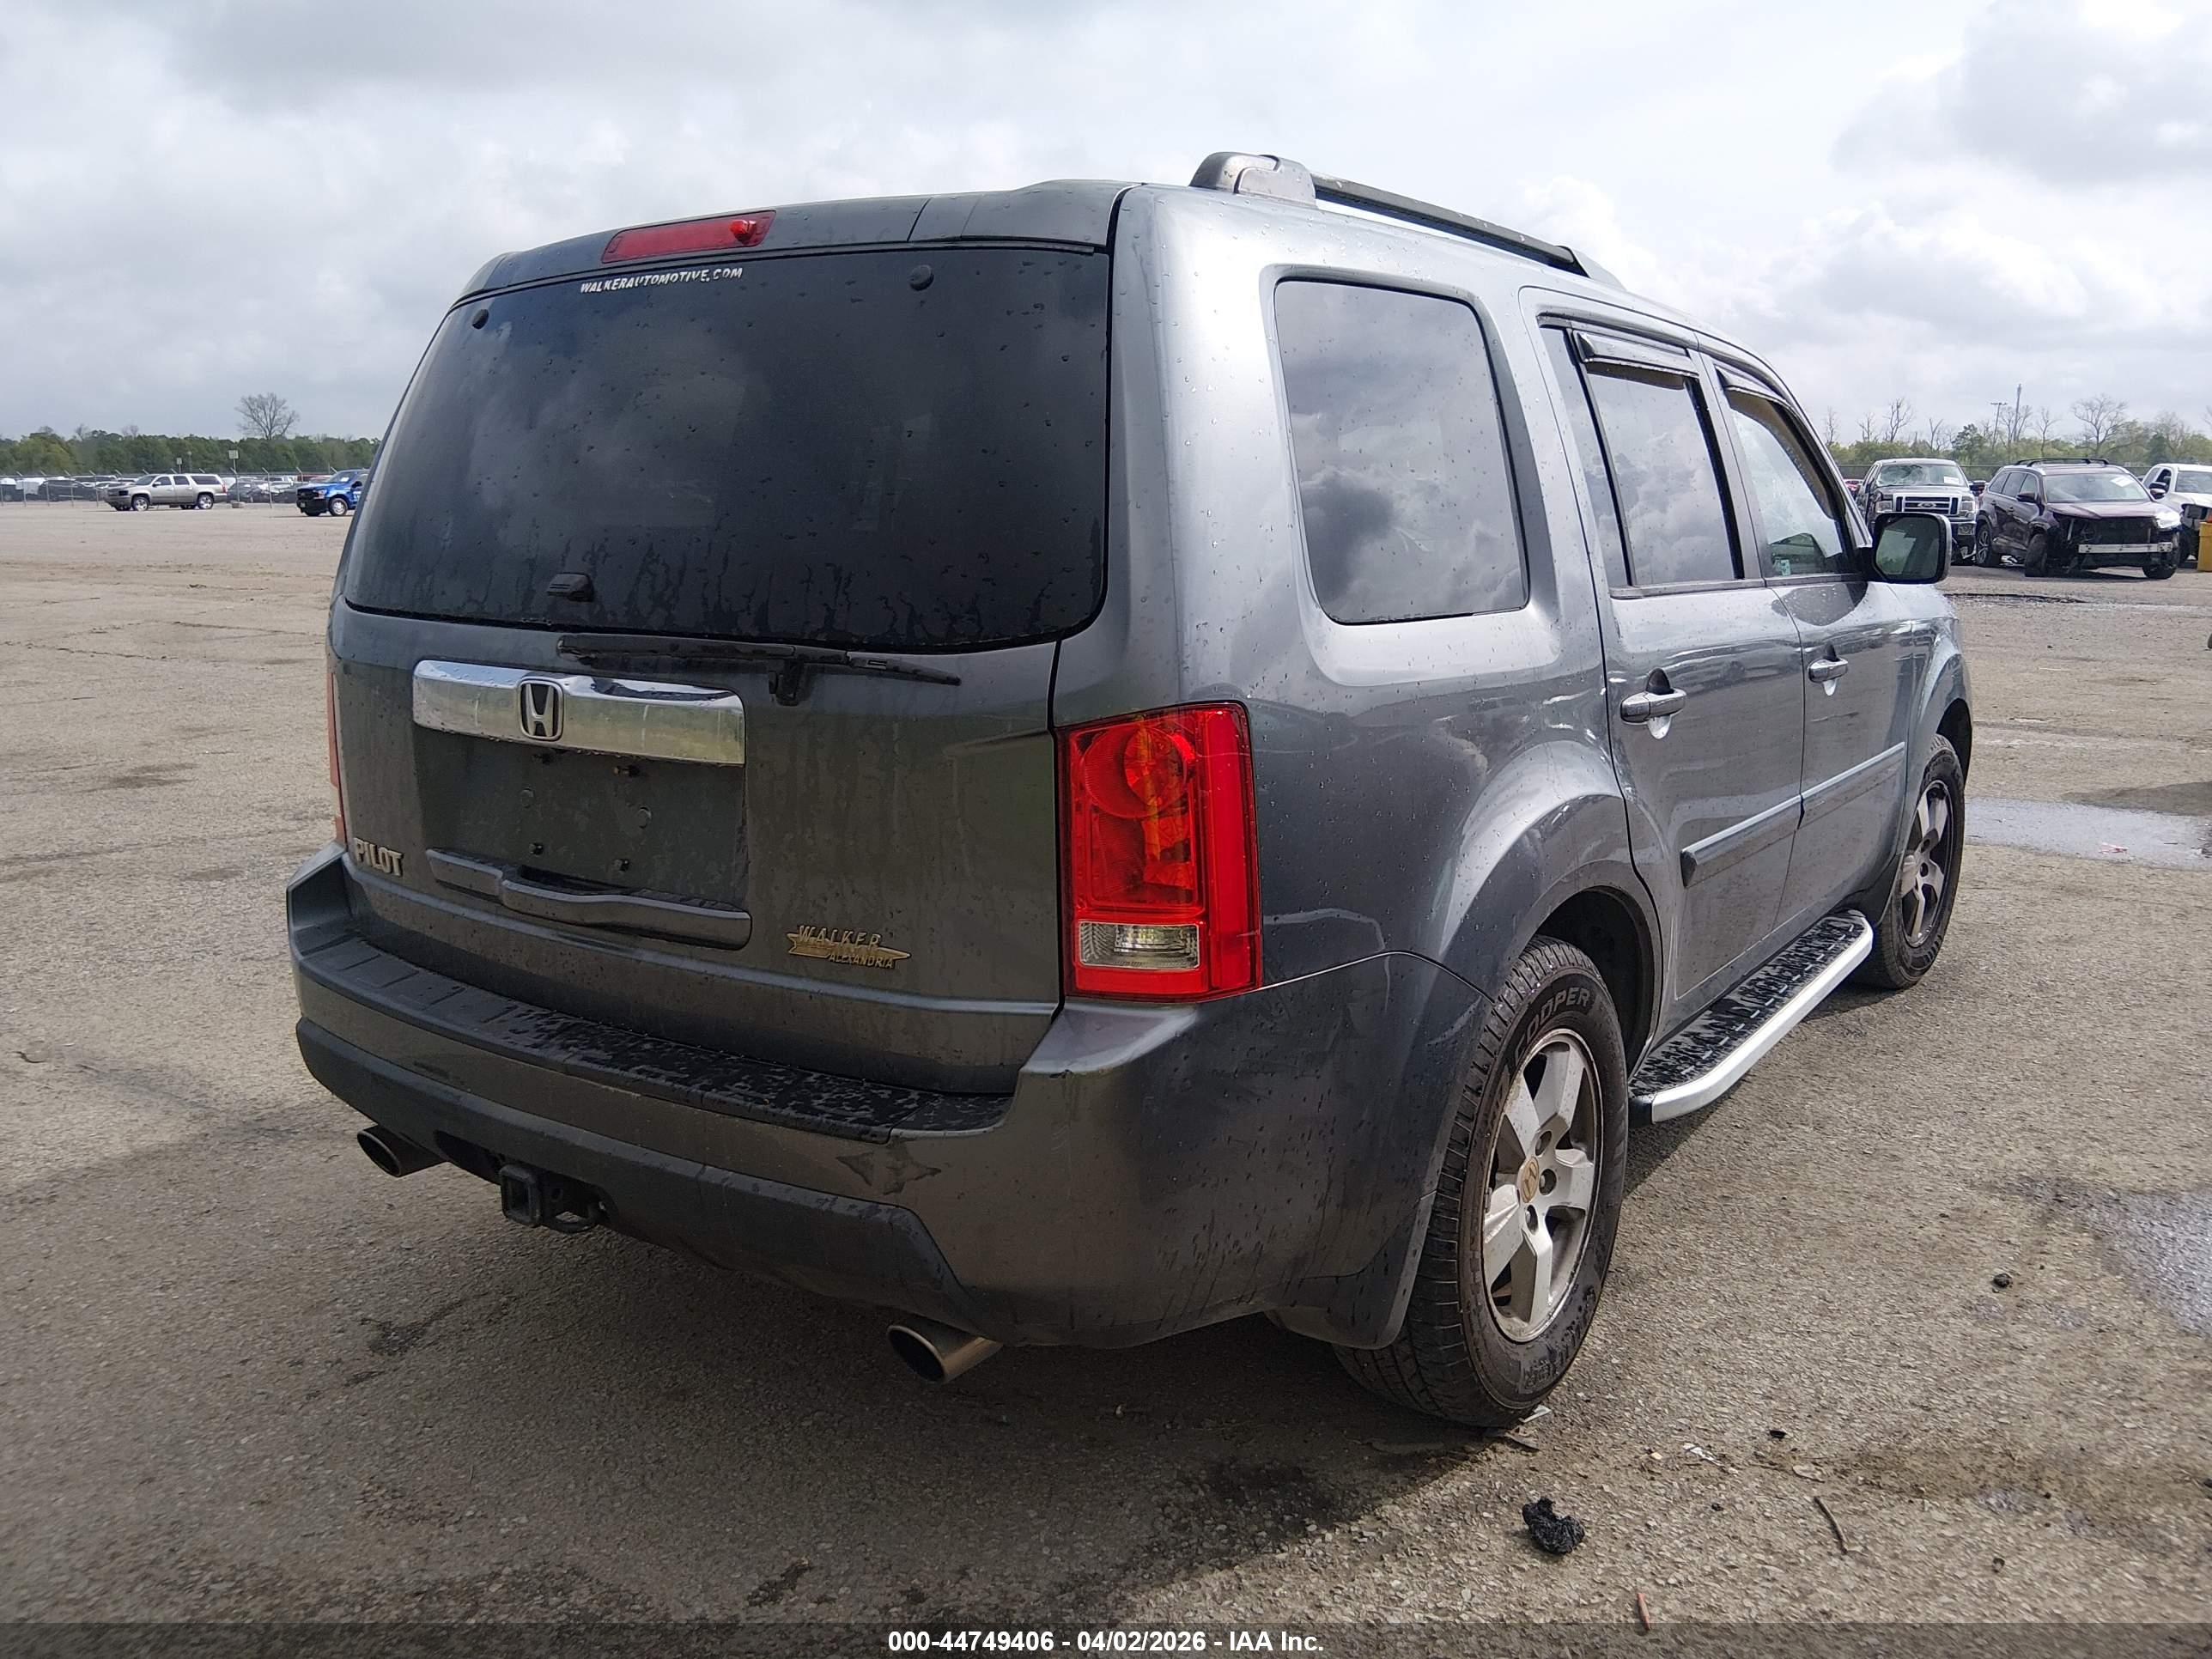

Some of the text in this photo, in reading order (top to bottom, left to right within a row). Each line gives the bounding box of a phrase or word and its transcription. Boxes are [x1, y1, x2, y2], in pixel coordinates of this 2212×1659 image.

[580, 267, 744, 294] WALKERAUTOMOTIVE.COM
[353, 836, 404, 877] PILOT
[799, 925, 882, 949] WALKER
[829, 952, 895, 969] ALEXANDRIA
[1514, 986, 1590, 1066] COOPER
